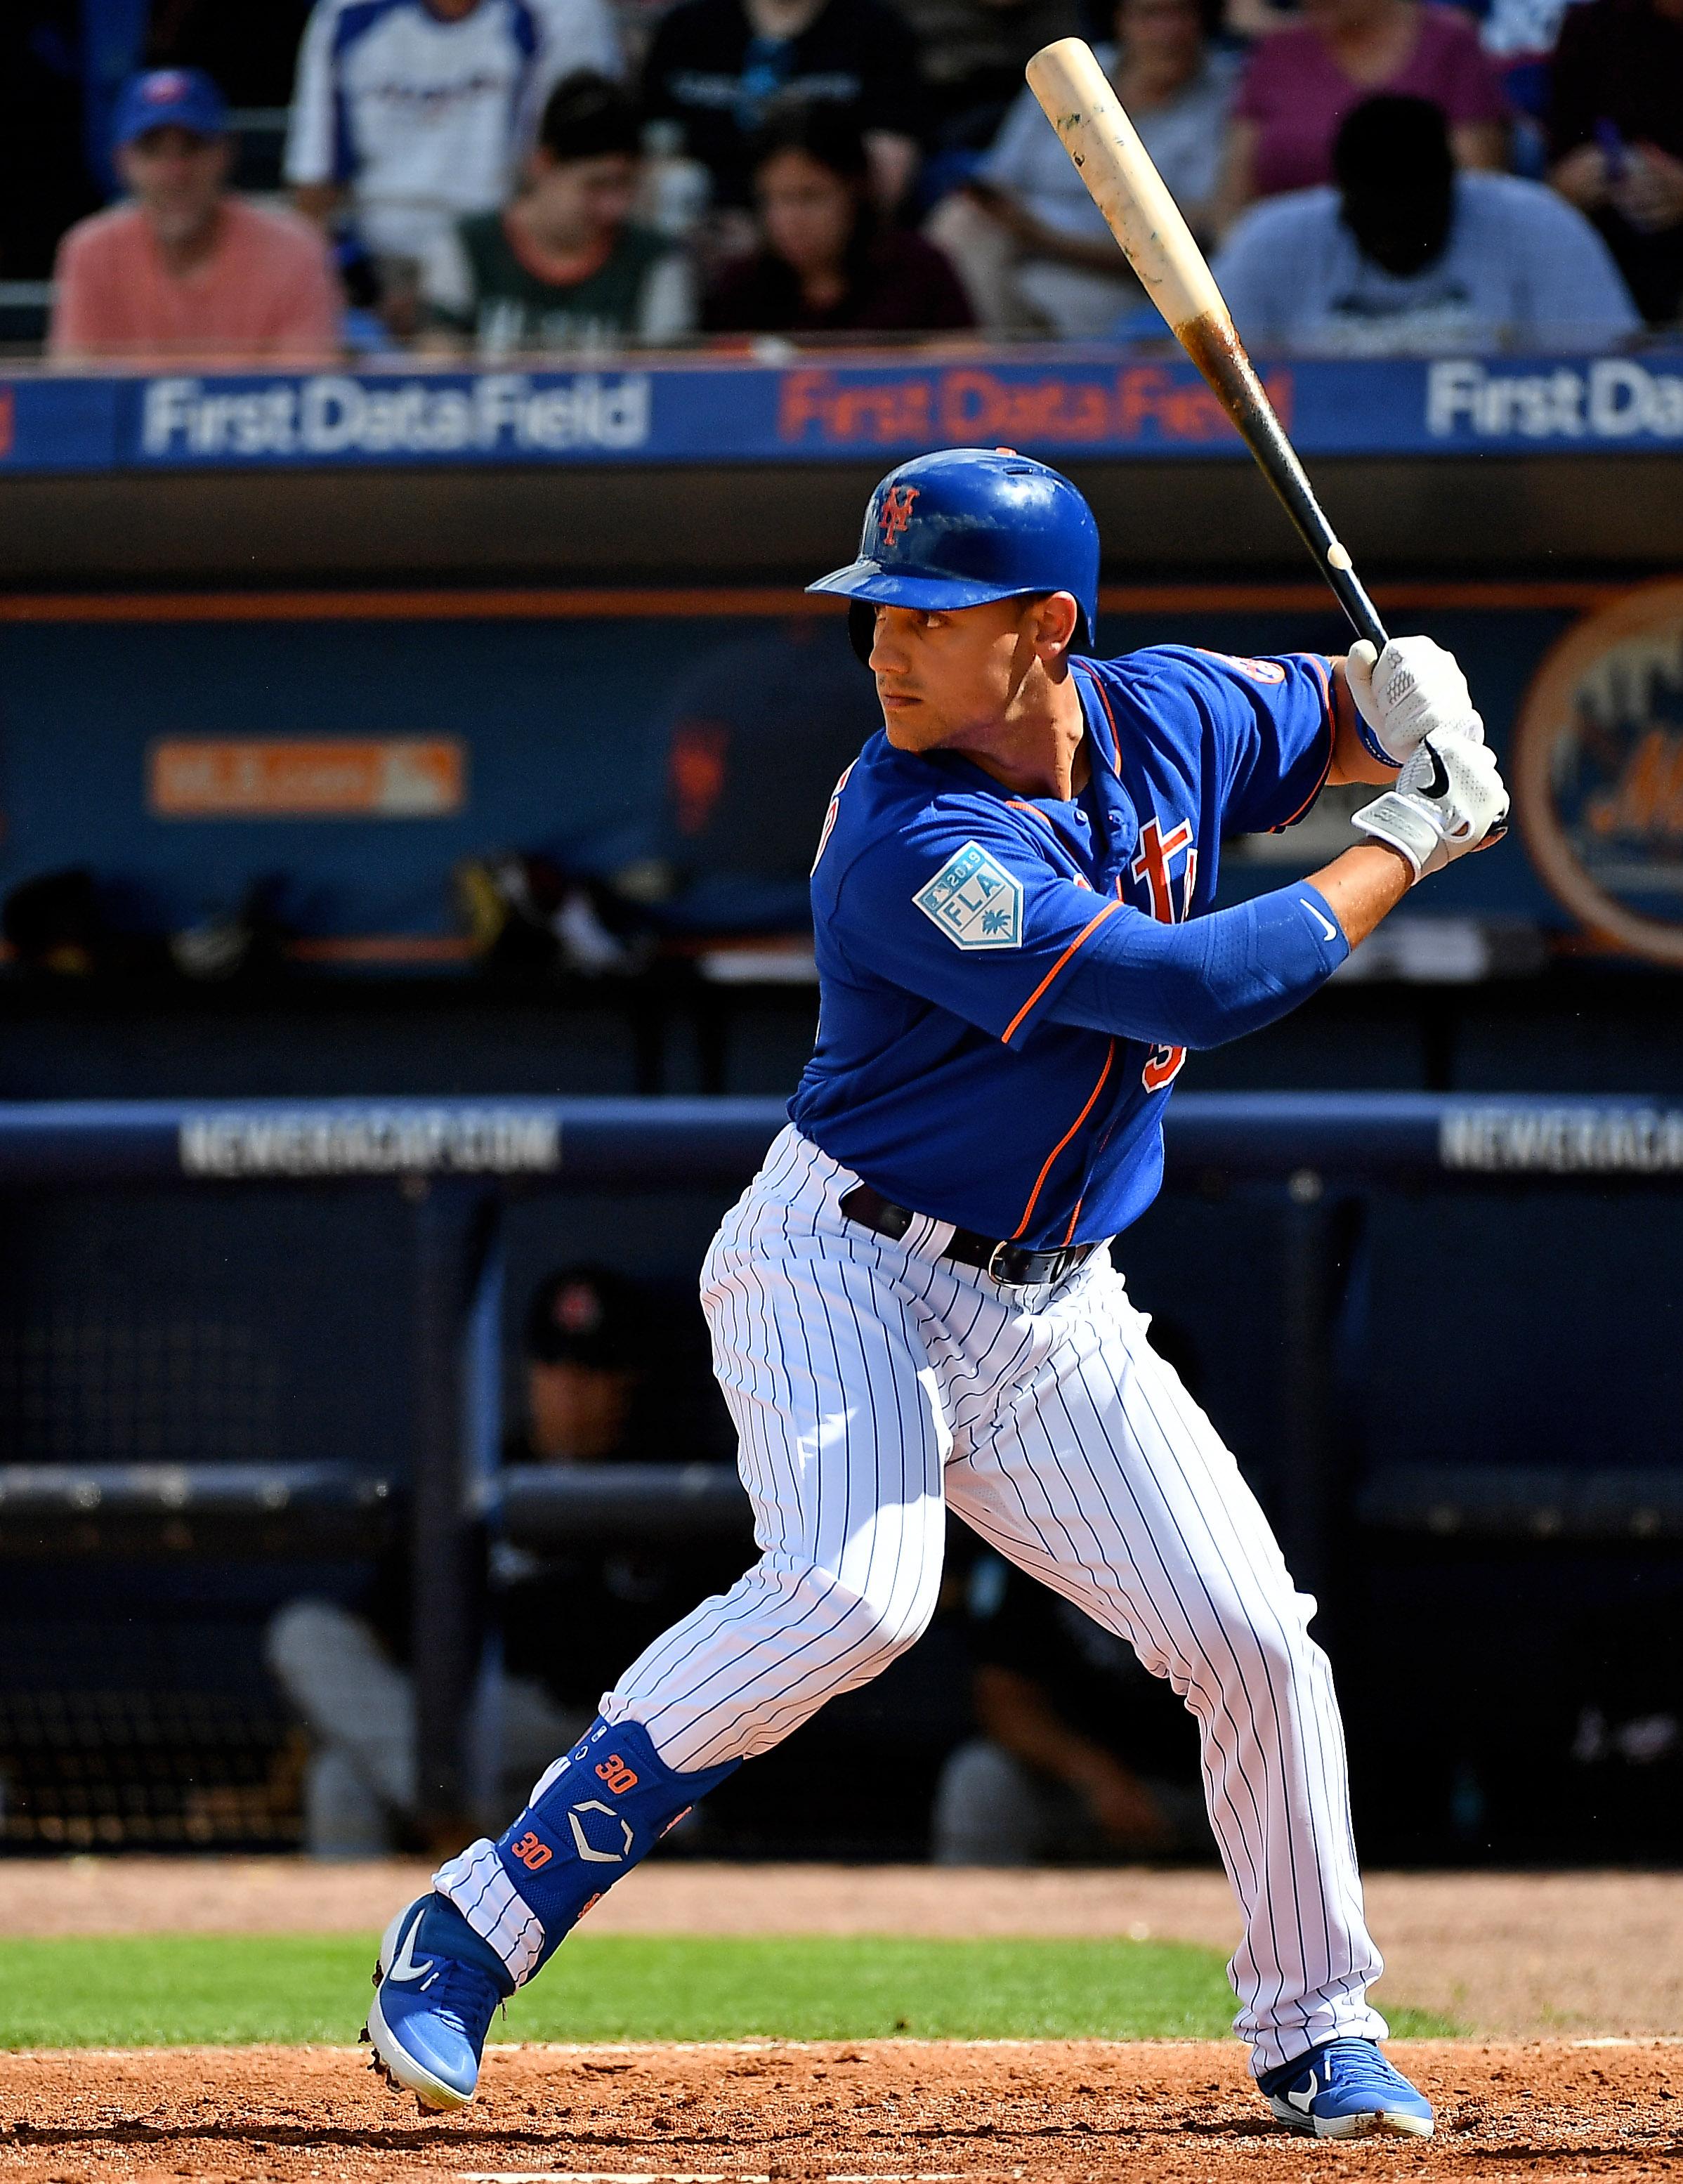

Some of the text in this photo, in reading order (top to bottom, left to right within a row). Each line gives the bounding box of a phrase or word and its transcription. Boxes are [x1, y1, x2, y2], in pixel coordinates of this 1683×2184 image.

[143, 372, 651, 454] First Data Field
[778, 371, 931, 443] First
[939, 369, 1108, 443] Data
[1427, 360, 1585, 437] First
[948, 851, 981, 887] 2019
[943, 873, 1002, 927] FLA
[595, 1754, 638, 1794] 30
[511, 1831, 552, 1870] 30
